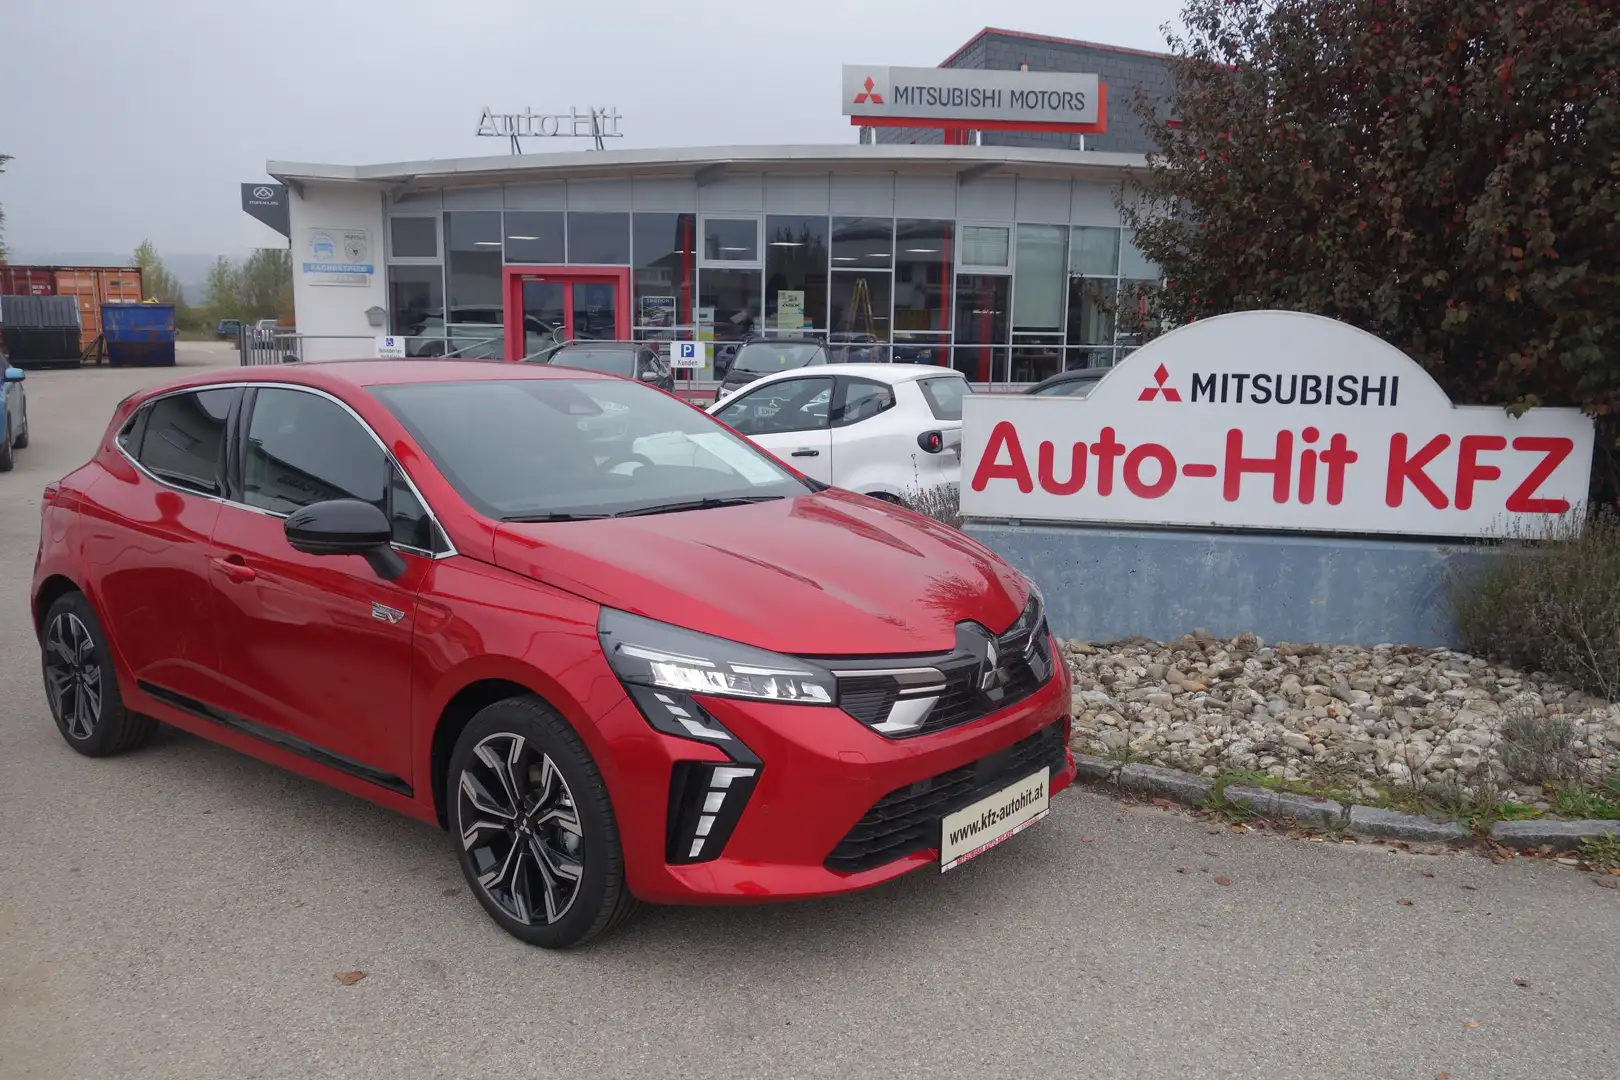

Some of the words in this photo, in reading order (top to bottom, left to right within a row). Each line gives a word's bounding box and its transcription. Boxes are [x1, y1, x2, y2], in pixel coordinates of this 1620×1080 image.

[894, 85, 1002, 108] MITSUBISHI
[1010, 89, 1086, 112] MOTORS
[475, 105, 558, 137] Auto
[571, 106, 623, 137] Hit
[683, 344, 692, 357] P
[1190, 372, 1399, 407] MITSUBISHI
[971, 420, 1358, 506] Auto-Hit
[1385, 432, 1574, 513] KFZ
[949, 782, 1044, 846] www.kfz-autohit.at
